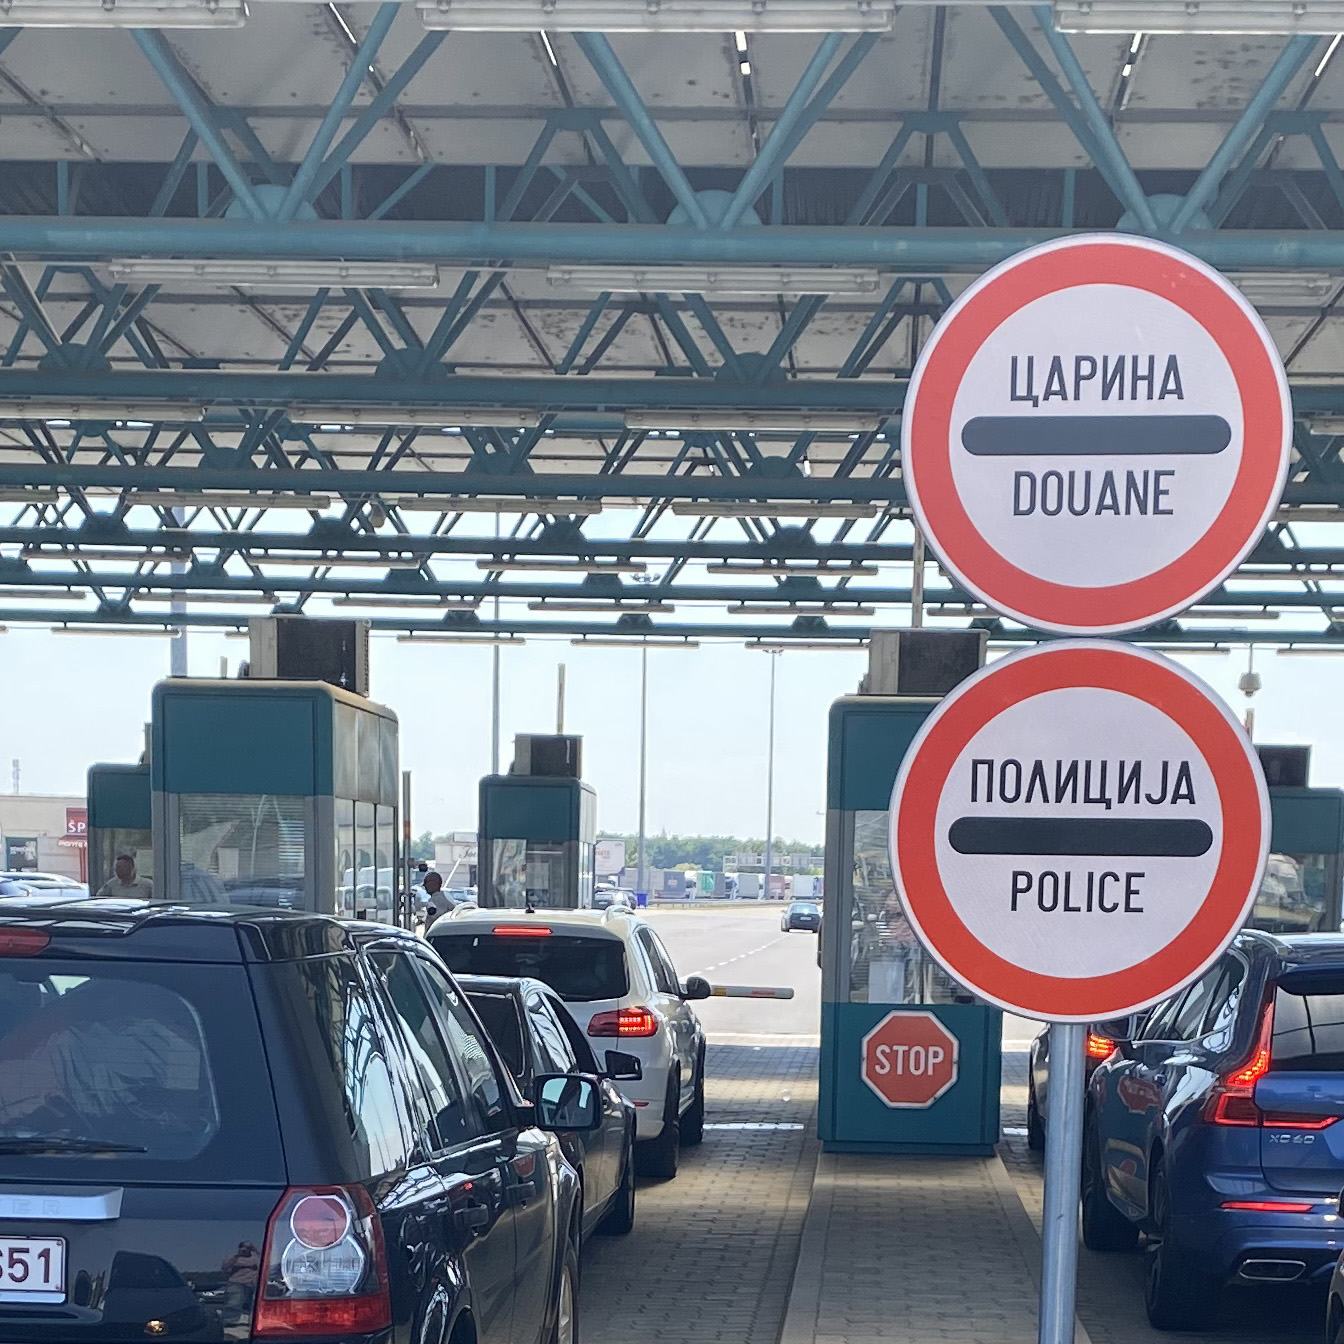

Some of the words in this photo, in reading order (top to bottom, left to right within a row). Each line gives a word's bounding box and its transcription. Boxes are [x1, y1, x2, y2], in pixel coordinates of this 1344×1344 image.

[1009, 354, 1184, 408] ЦАРИНА
[1013, 469, 1176, 517] DOUANE
[971, 758, 1197, 810] ПОЛИЦИЈА
[1010, 870, 1145, 914] POLICE
[874, 1044, 945, 1076] STOP
